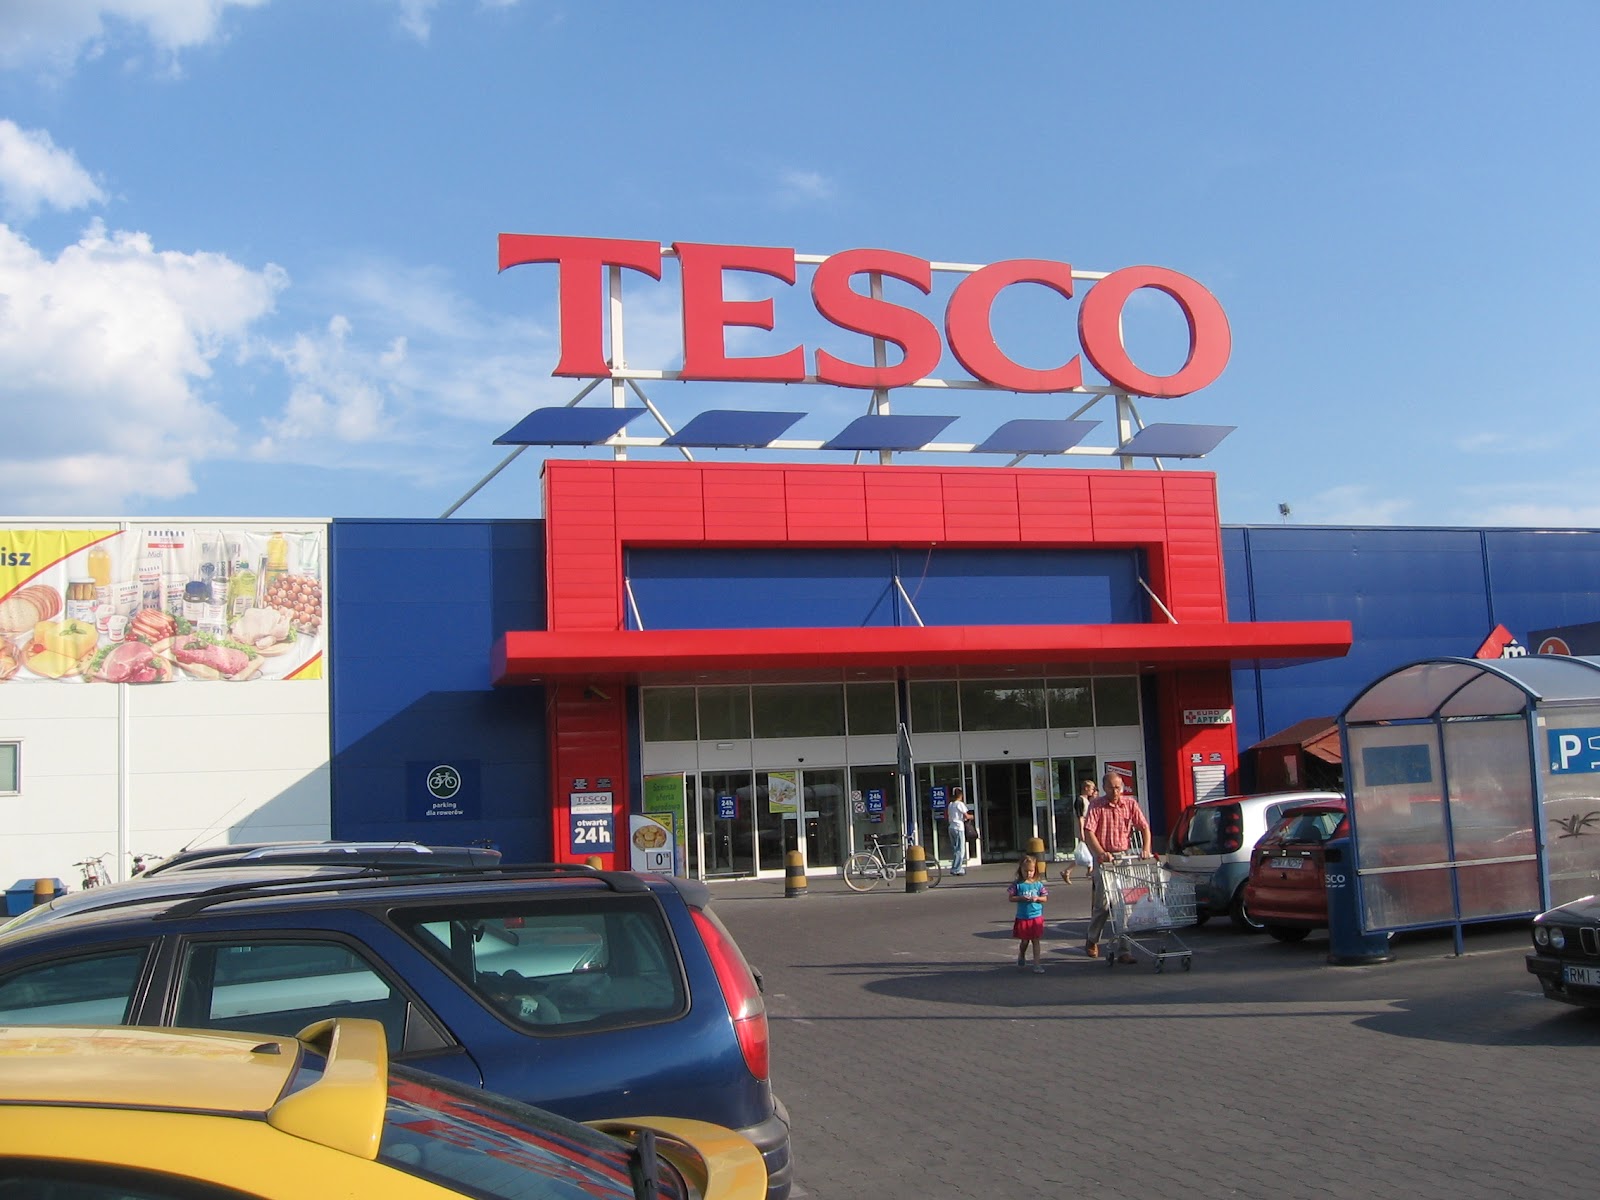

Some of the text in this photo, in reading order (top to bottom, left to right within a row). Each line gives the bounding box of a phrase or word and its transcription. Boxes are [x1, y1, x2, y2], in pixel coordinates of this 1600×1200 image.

[499, 233, 1232, 398] TESCO
[1, 546, 31, 566] isz
[1559, 734, 1582, 769] P
[576, 795, 608, 803] TESCO
[576, 819, 608, 827] otwarte
[574, 826, 611, 844] 24h
[1570, 967, 1590, 984] RMI
